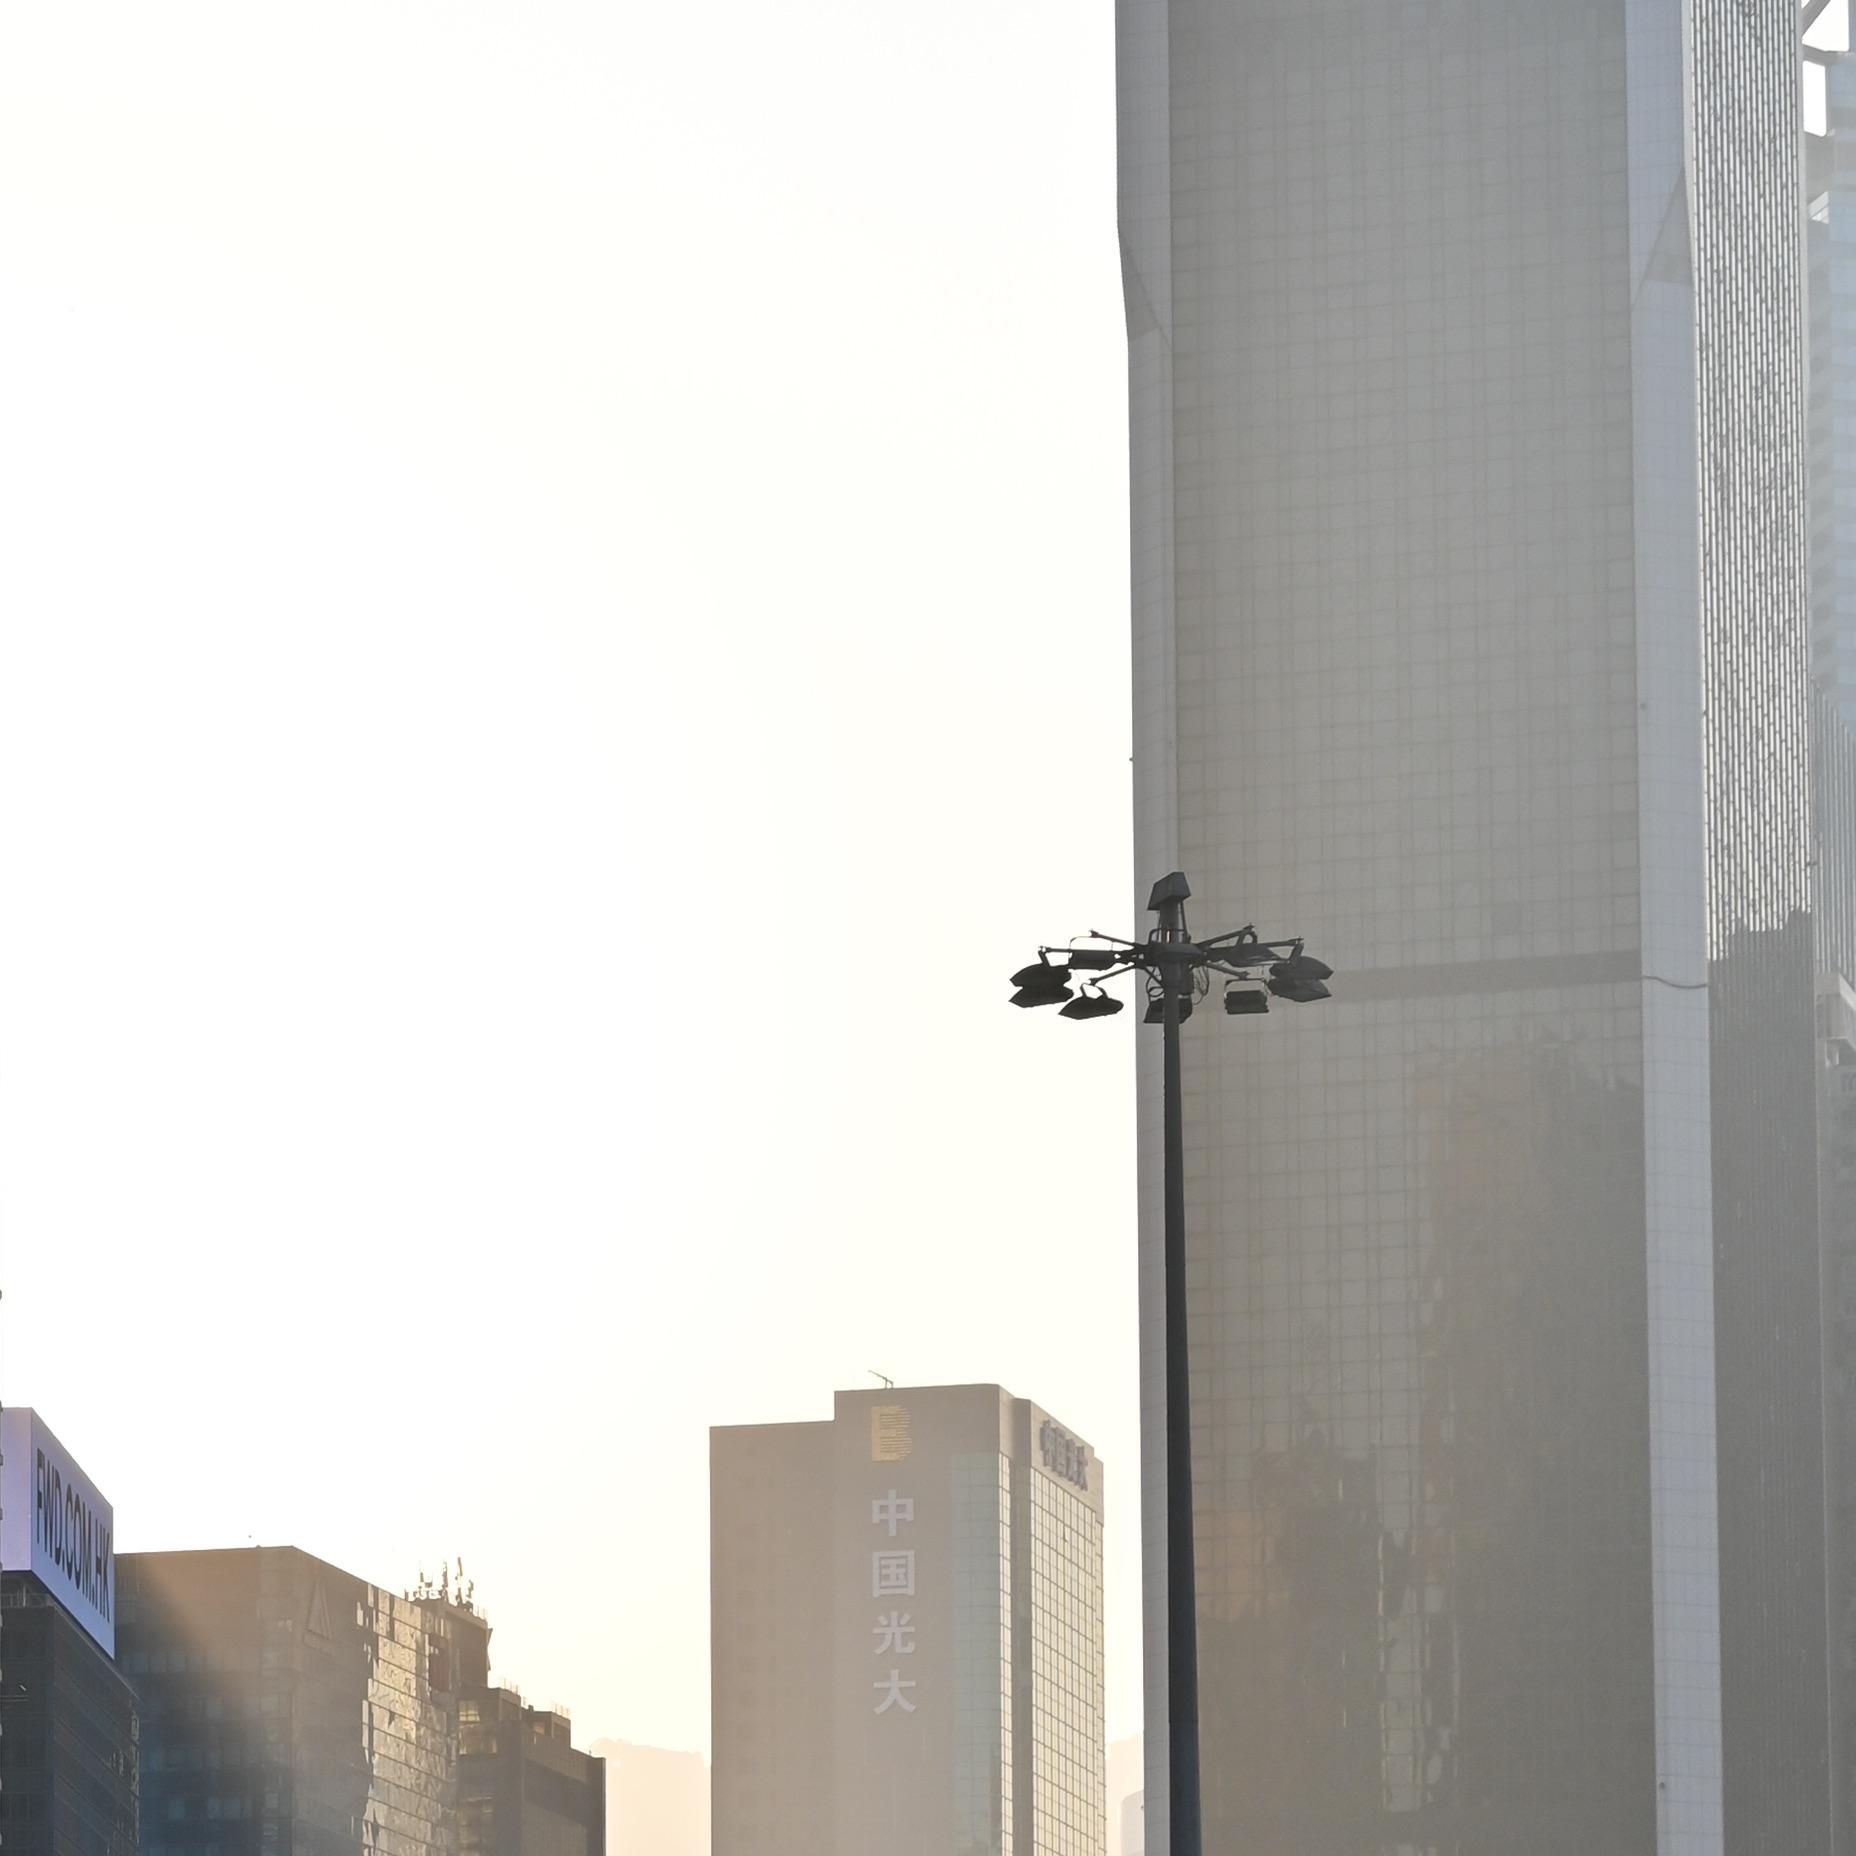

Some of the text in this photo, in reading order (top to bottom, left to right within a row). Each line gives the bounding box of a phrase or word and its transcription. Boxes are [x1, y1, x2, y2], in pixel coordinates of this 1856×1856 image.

[37, 1448, 110, 1623] FWD.COM.HK
[872, 1489, 917, 1714] 中国光大
